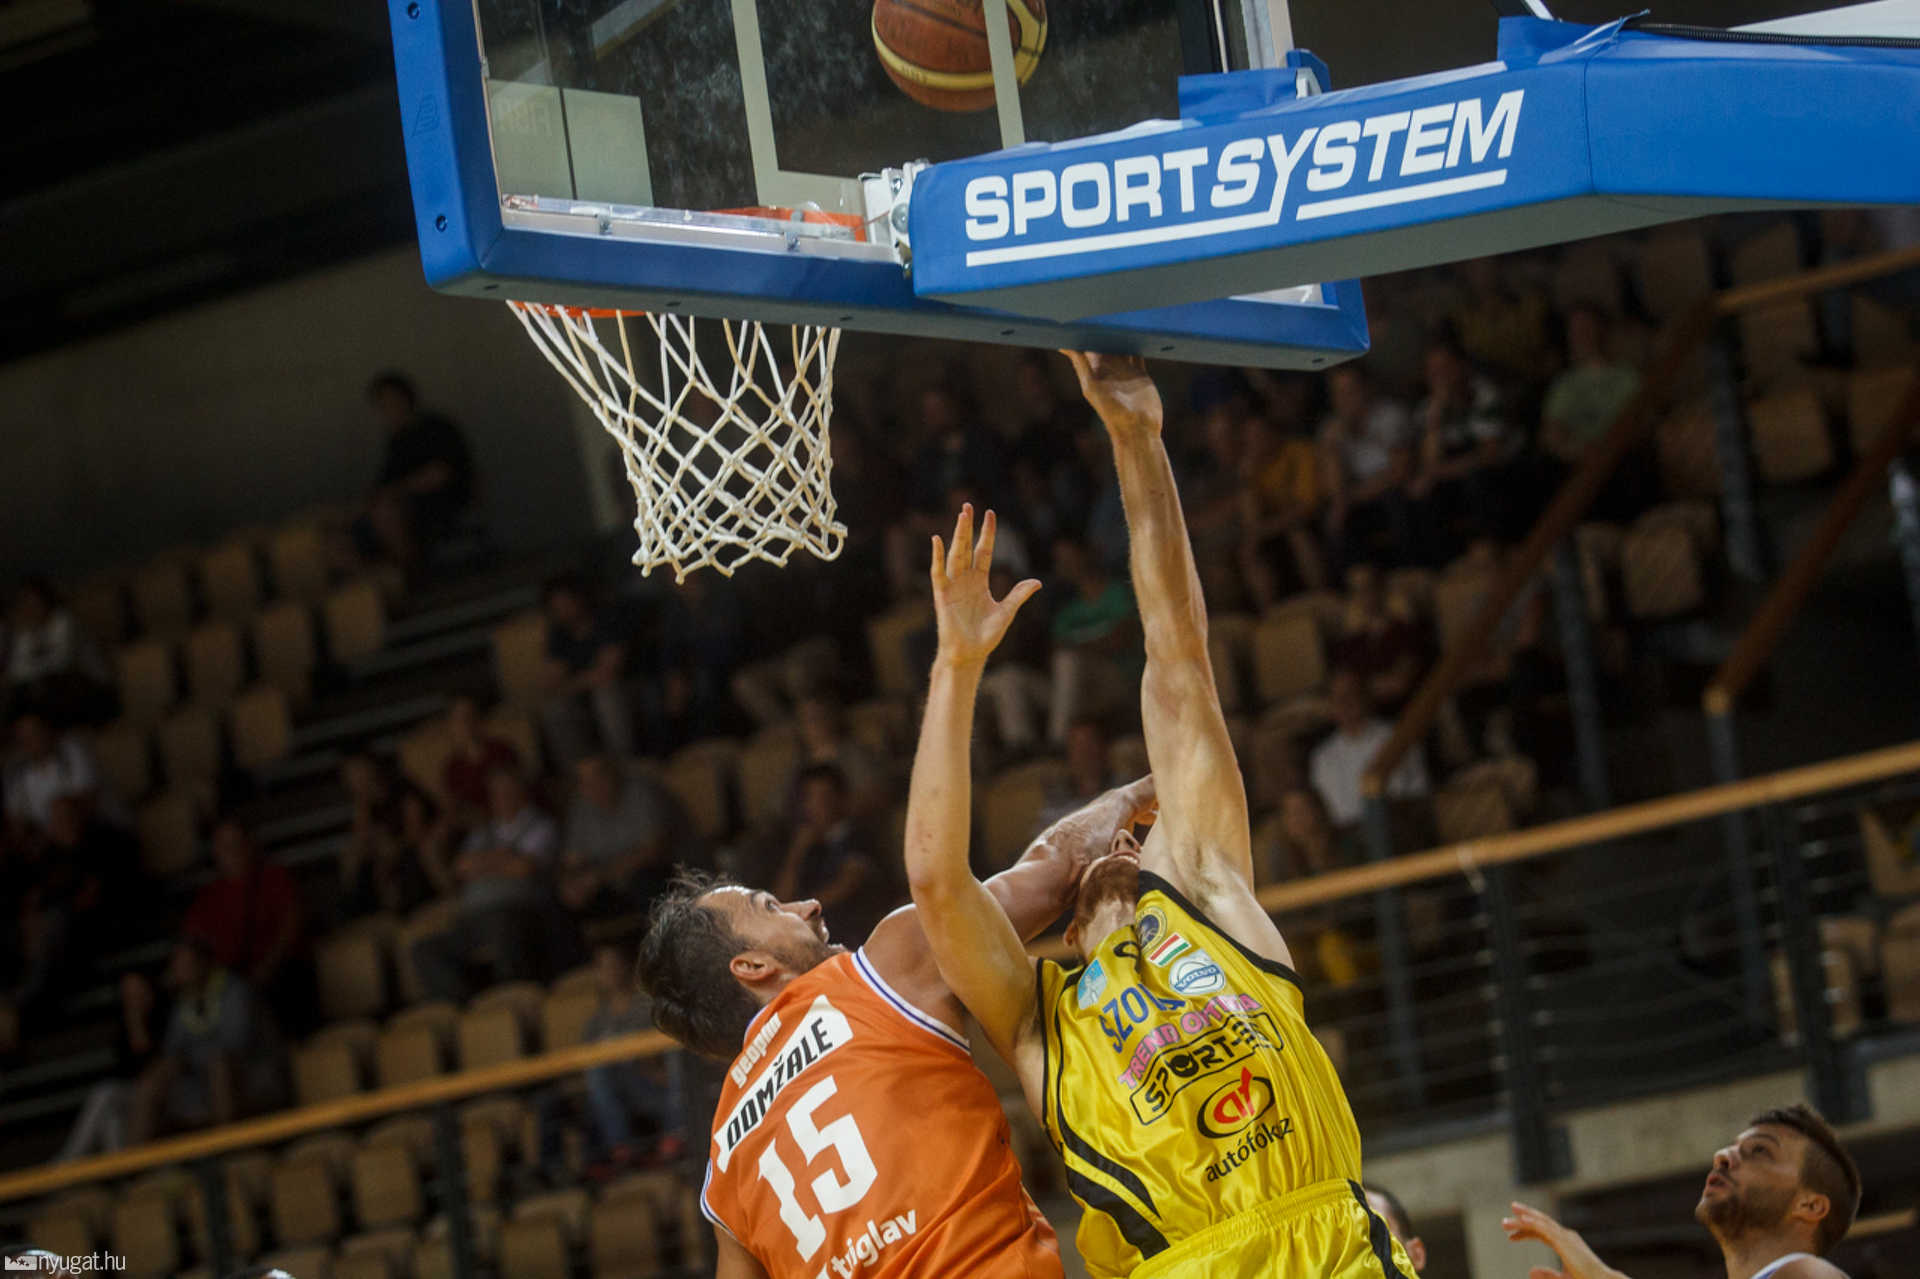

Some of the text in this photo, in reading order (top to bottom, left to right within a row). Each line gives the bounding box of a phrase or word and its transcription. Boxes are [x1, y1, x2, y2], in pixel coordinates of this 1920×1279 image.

[727, 1016, 833, 1152] DOMŽALE
[1117, 1022, 1181, 1091] TREND
[757, 1074, 878, 1264] 15
[831, 1209, 917, 1279] triglav
